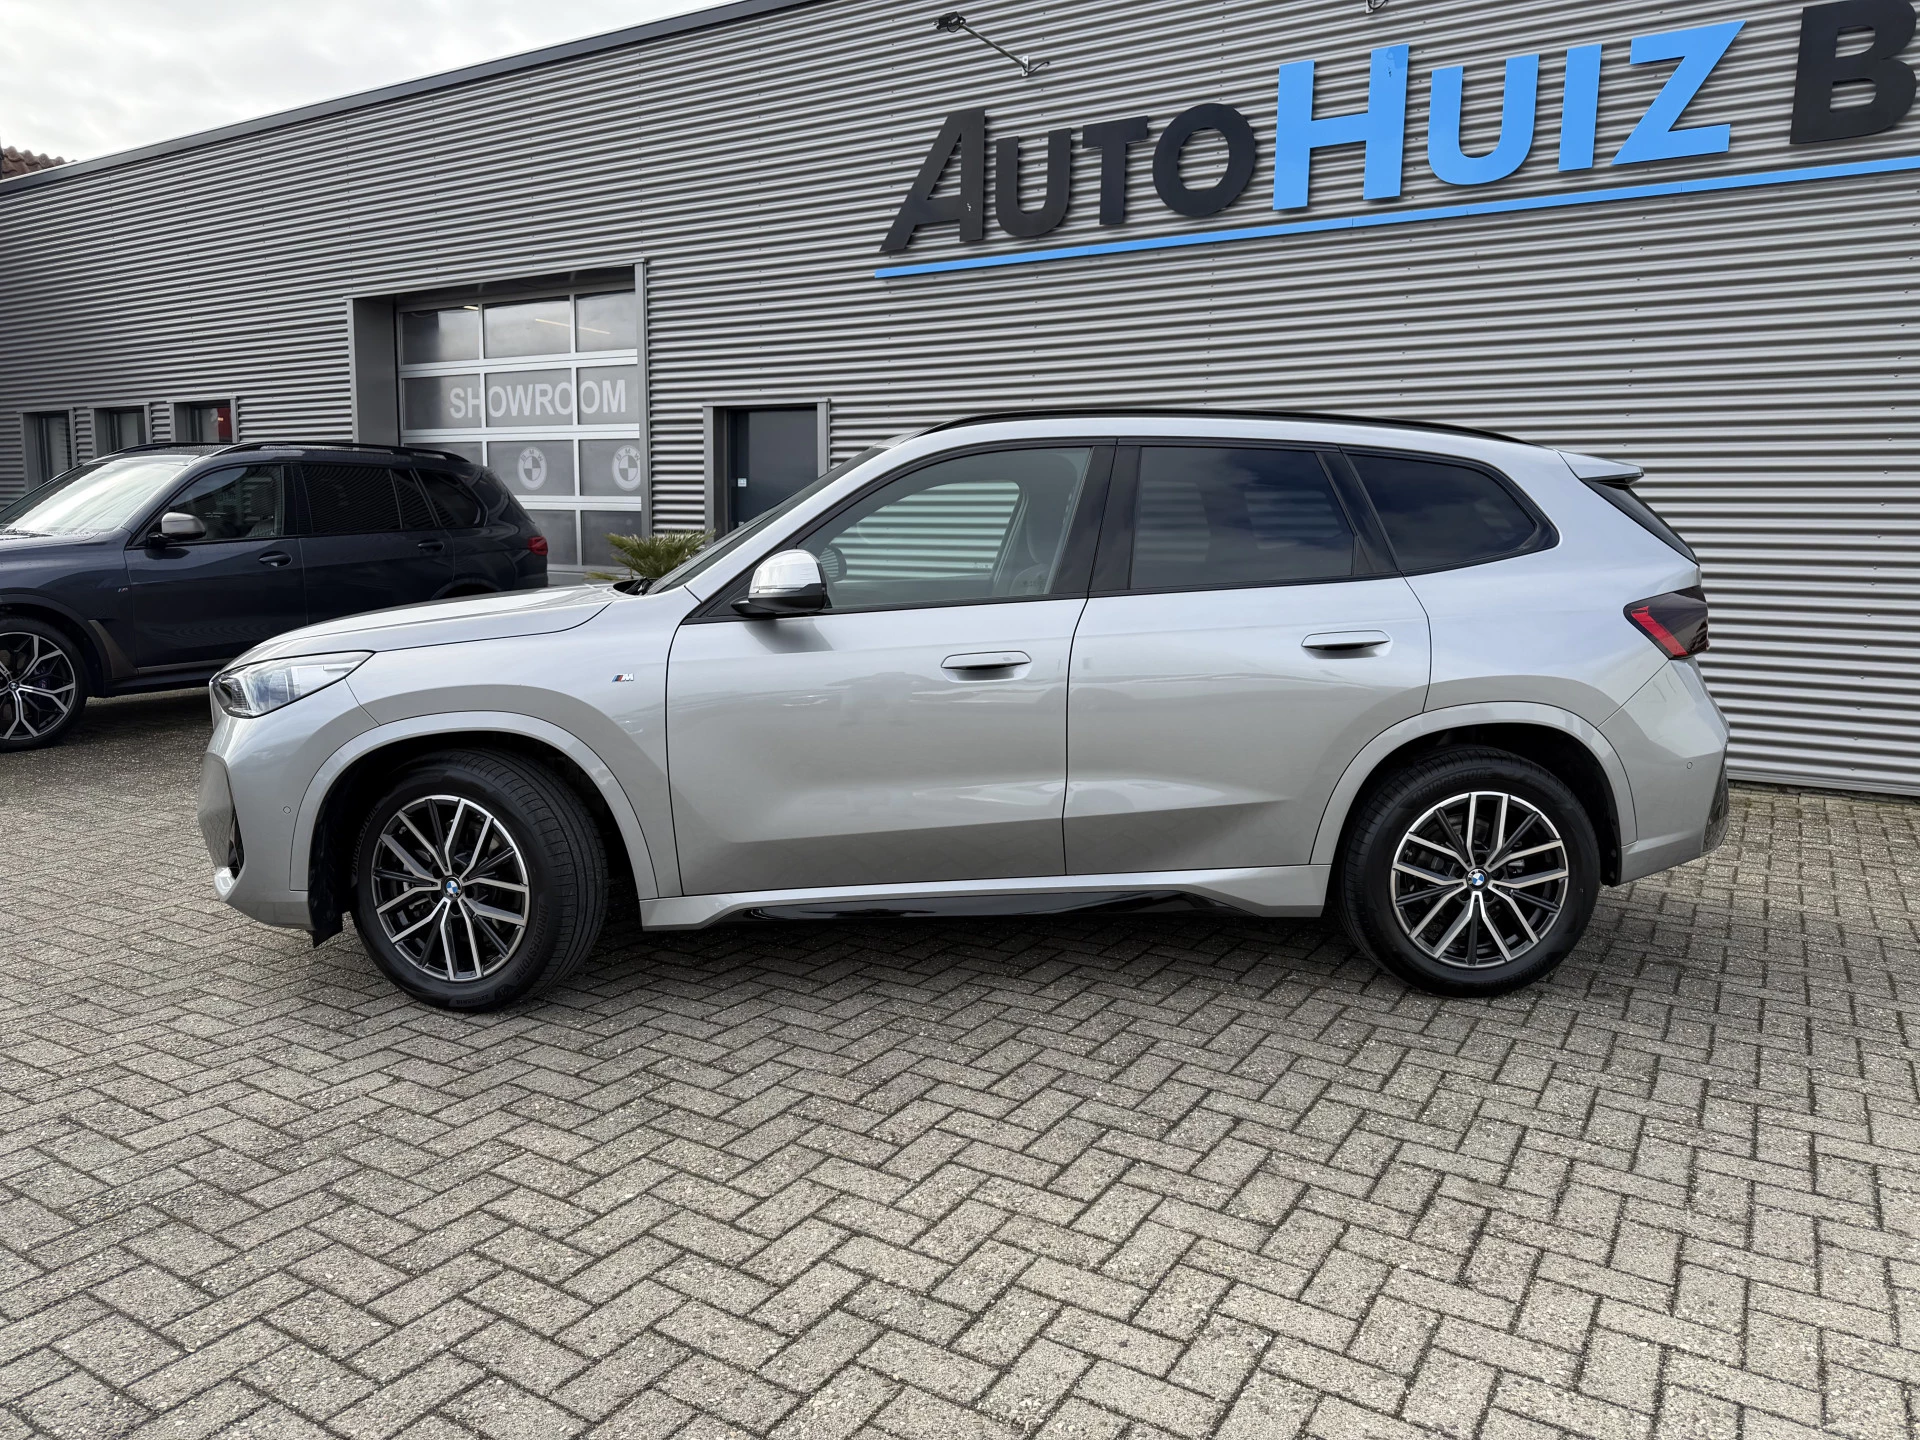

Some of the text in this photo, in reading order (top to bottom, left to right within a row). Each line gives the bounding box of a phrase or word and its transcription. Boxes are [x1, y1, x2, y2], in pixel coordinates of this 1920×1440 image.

[879, 0, 1917, 252] AUTOHUIZ B
[450, 379, 626, 418] SHOWROOM
